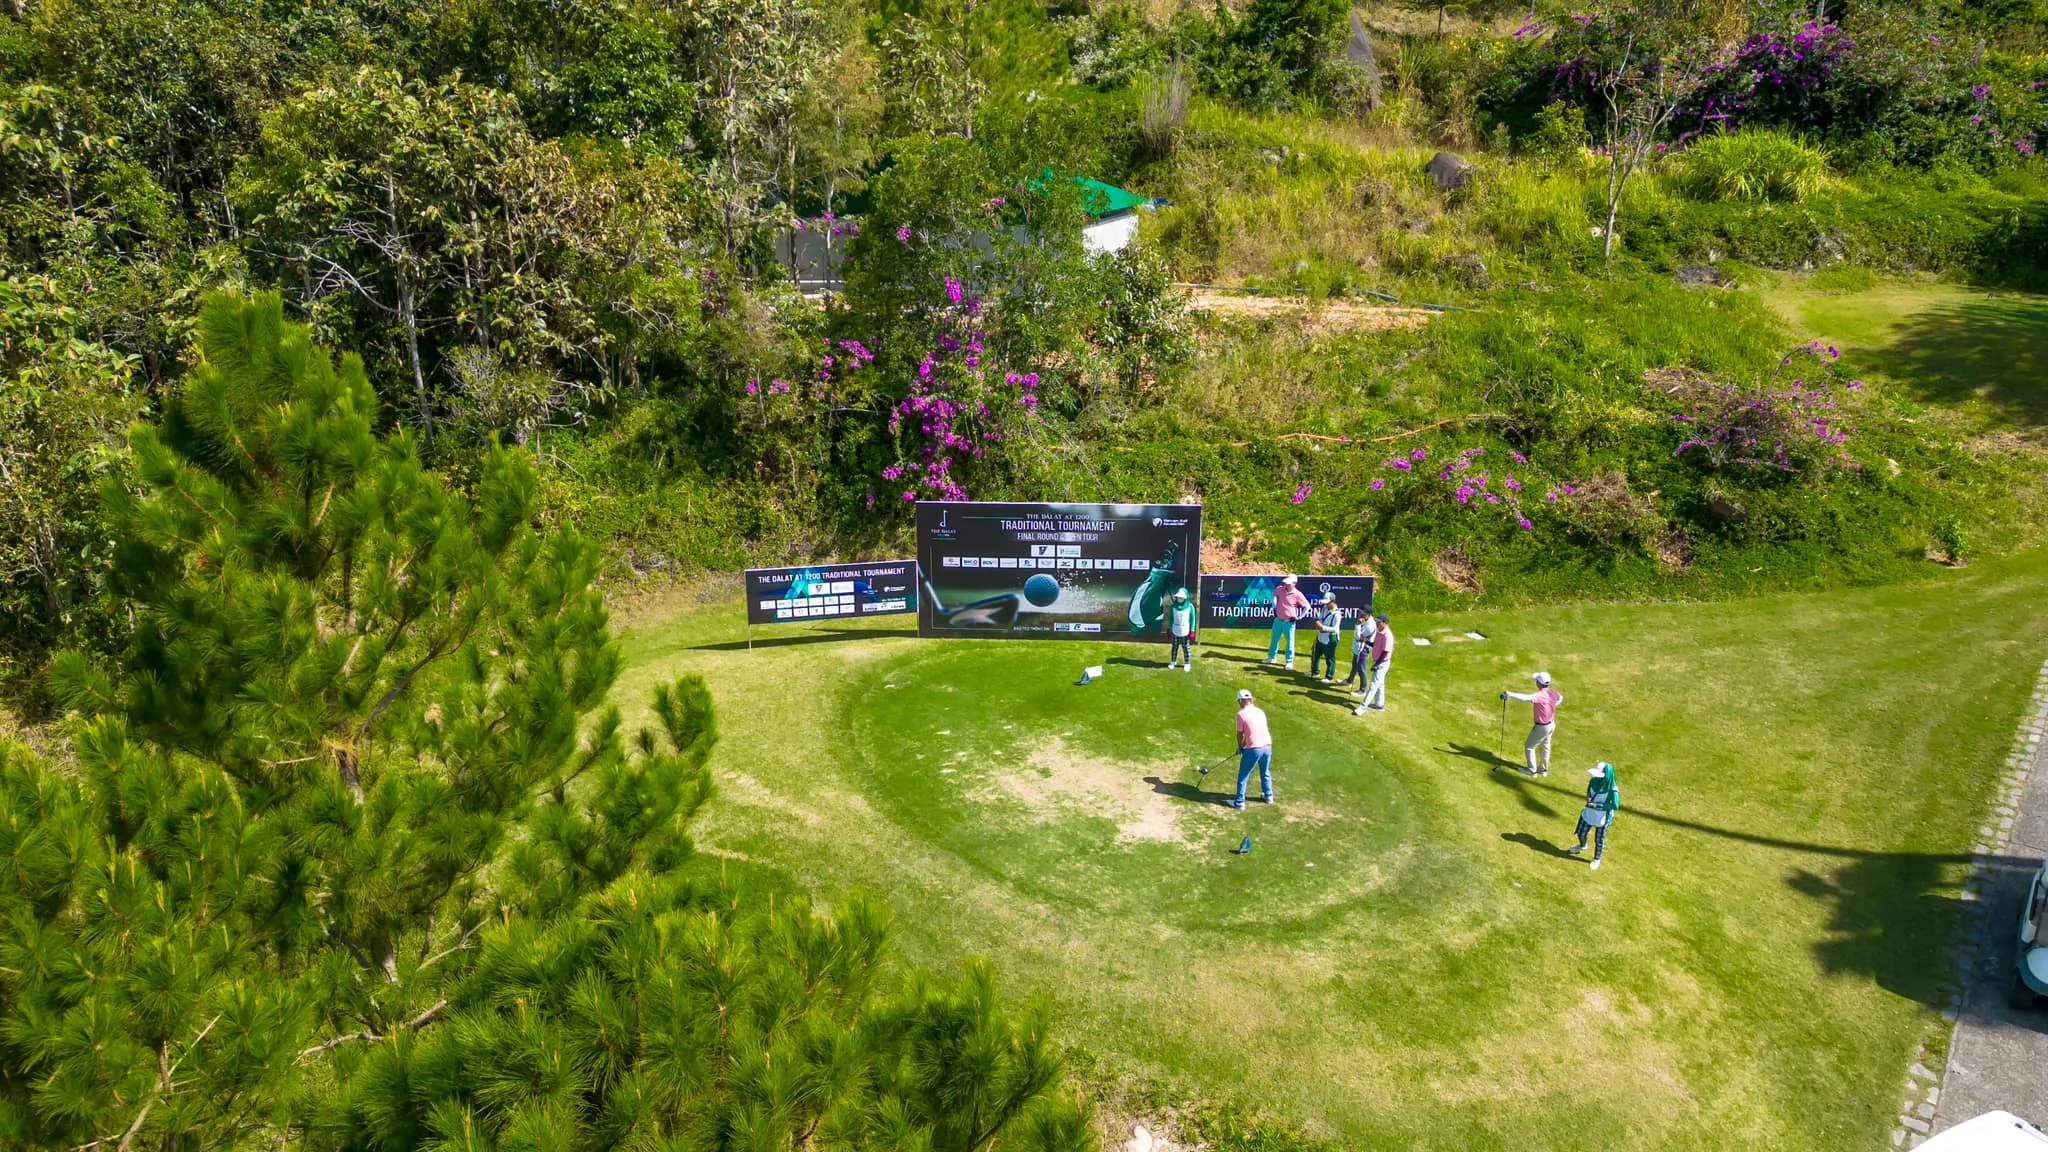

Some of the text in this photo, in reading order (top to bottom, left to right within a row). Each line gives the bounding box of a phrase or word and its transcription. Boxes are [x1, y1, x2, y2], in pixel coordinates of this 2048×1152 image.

[1001, 520, 1116, 531] TRADITIONAL TOURNAMENT
[1082, 533, 1099, 541] TOUR
[758, 576, 771, 584] THE
[822, 570, 862, 580] TRADITIONAL
[863, 568, 905, 577] TOURNAMENT
[1211, 606, 1275, 617] TRADITIONA
